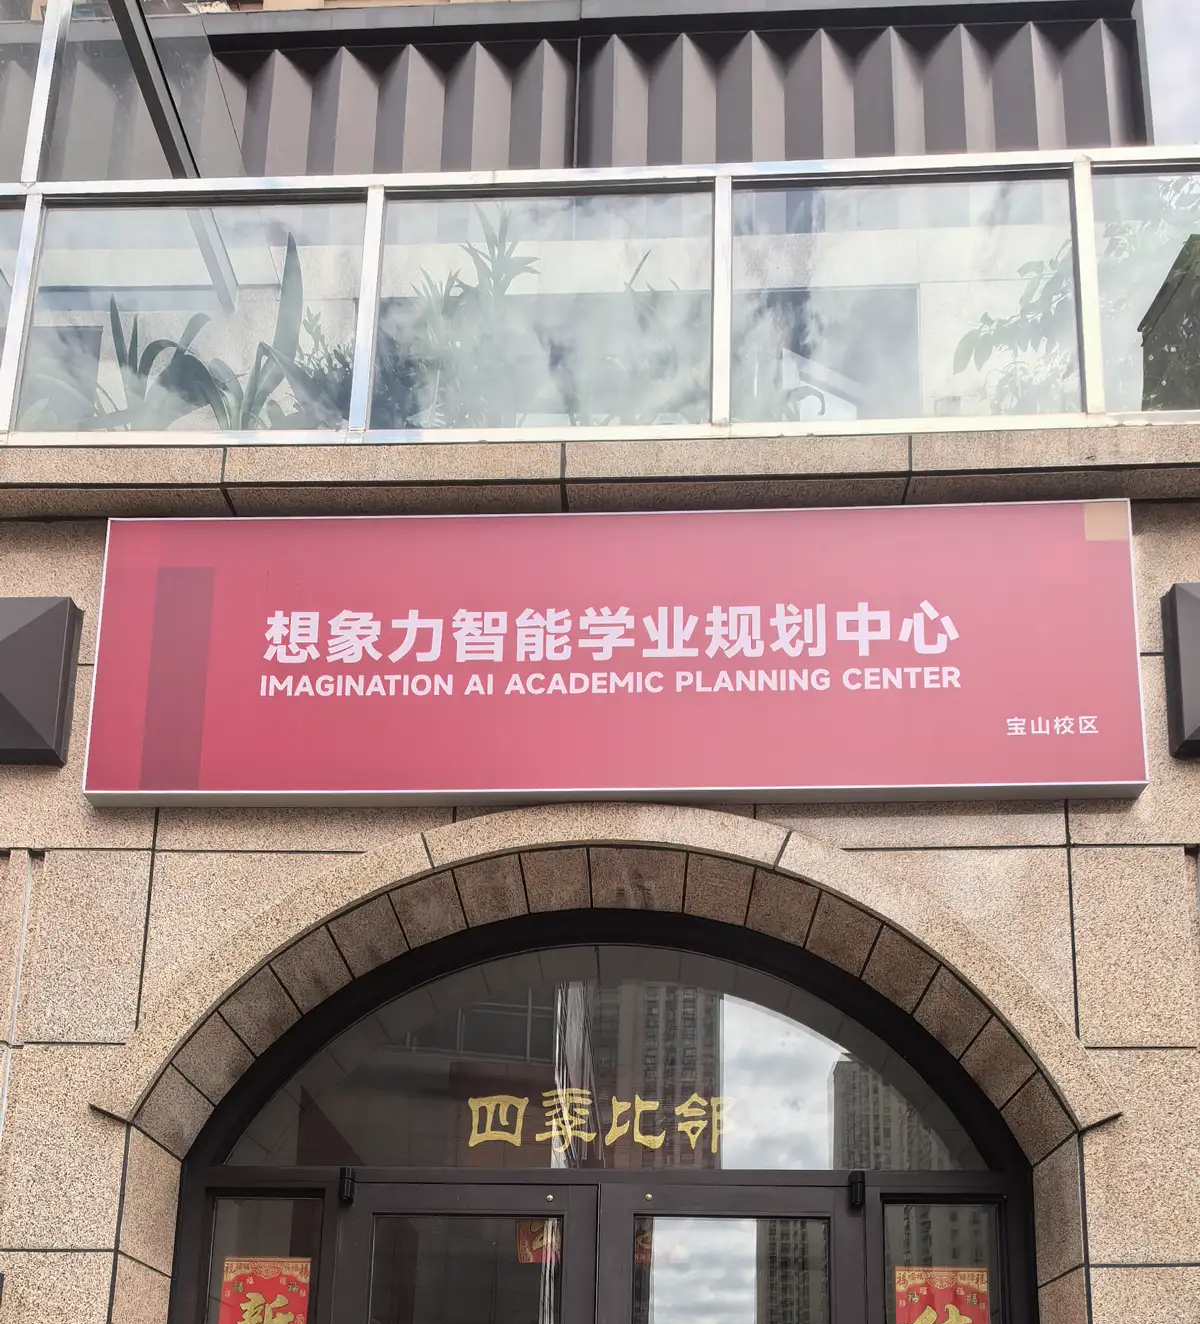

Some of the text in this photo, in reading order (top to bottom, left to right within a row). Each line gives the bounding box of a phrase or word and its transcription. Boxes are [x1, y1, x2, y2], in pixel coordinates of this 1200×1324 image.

[263, 600, 960, 664] 想象力智能学业规划中心
[259, 666, 962, 697] IMAGINATION AI ACADEMIC PLANNING CENTER
[1006, 715, 1099, 736] 宝山校区
